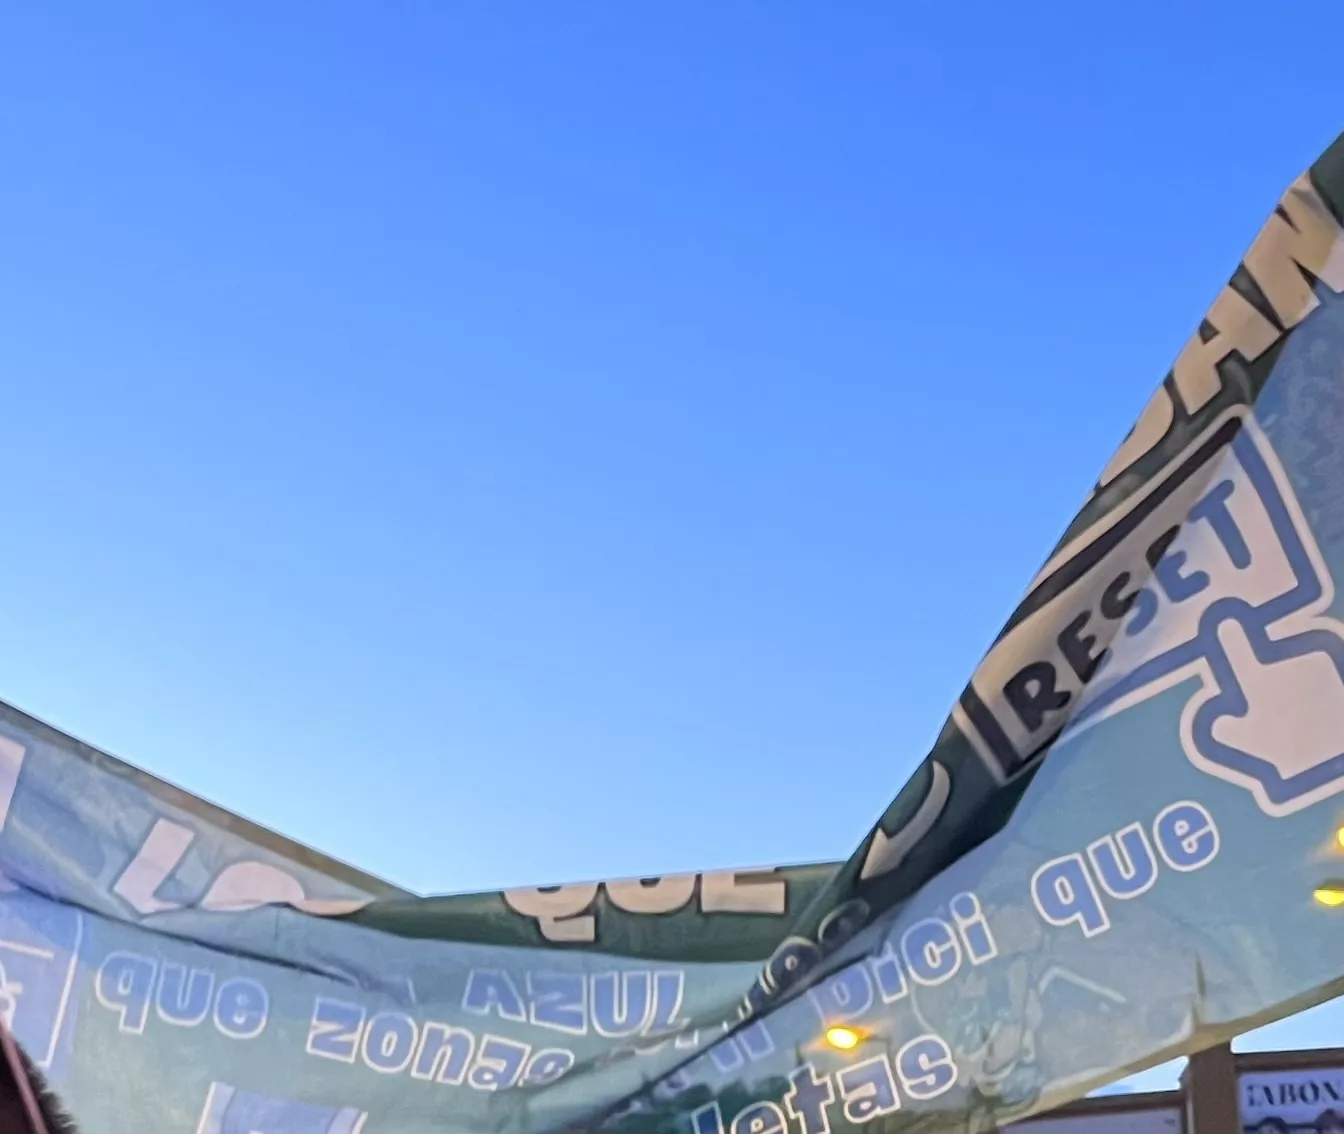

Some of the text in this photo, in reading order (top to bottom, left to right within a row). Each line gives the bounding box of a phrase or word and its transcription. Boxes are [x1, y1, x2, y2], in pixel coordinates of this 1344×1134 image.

[1002, 479, 1253, 733] RESET
[1031, 799, 1221, 938] que
[95, 951, 270, 1040] que
